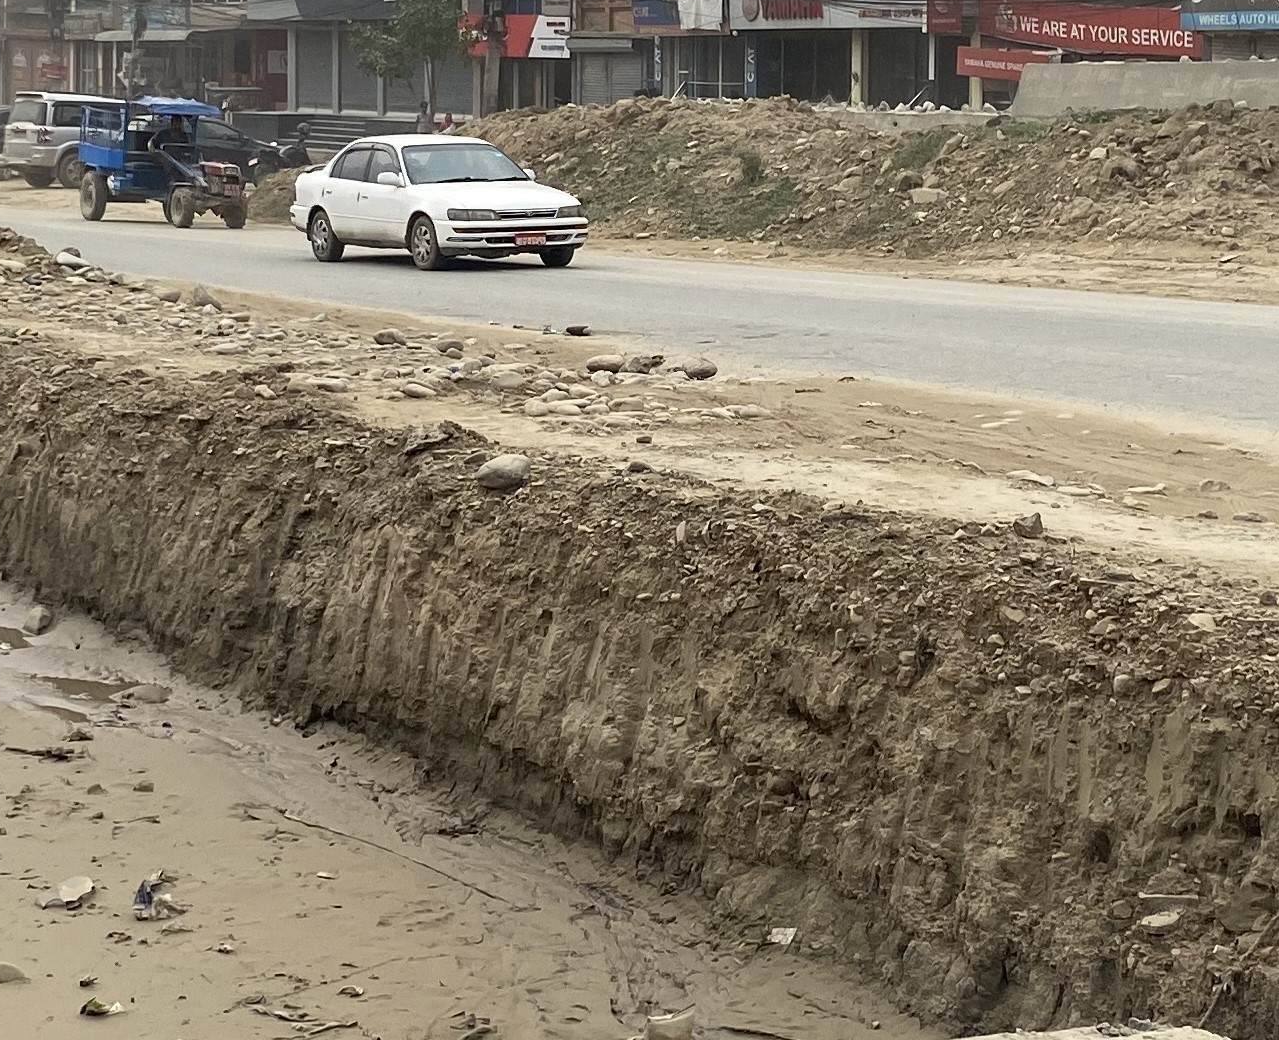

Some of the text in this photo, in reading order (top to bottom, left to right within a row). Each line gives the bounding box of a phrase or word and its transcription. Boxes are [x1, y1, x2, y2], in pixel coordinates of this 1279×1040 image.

[1199, 12, 1237, 25] WHEELS
[1239, 13, 1265, 25] AUTO
[1020, 16, 1194, 48] WE ARE AT YOUR SERVICE
